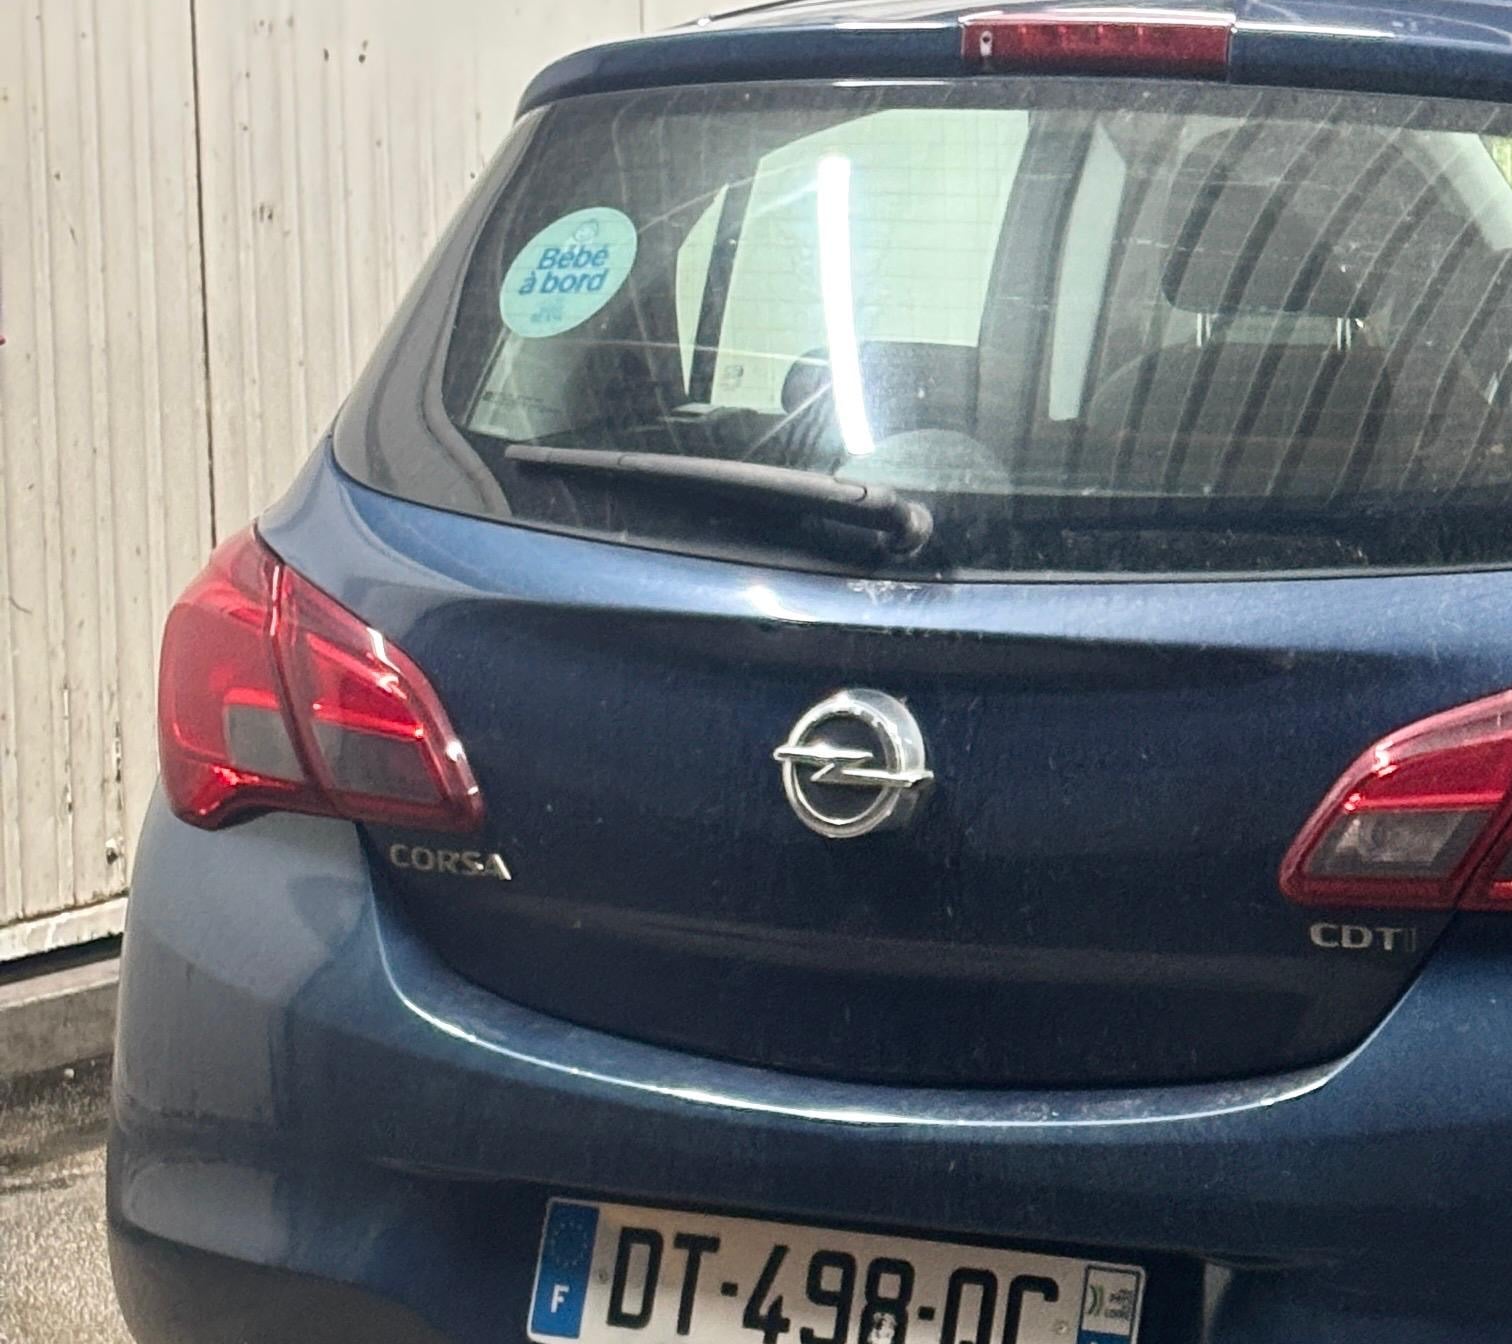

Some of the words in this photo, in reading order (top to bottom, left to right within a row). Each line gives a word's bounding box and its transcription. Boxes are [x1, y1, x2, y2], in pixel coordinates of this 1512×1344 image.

[536, 244, 609, 270] Bébé
[518, 270, 537, 296] à
[540, 269, 608, 294] bord
[389, 843, 512, 881] CORSA
[550, 1283, 570, 1314] F
